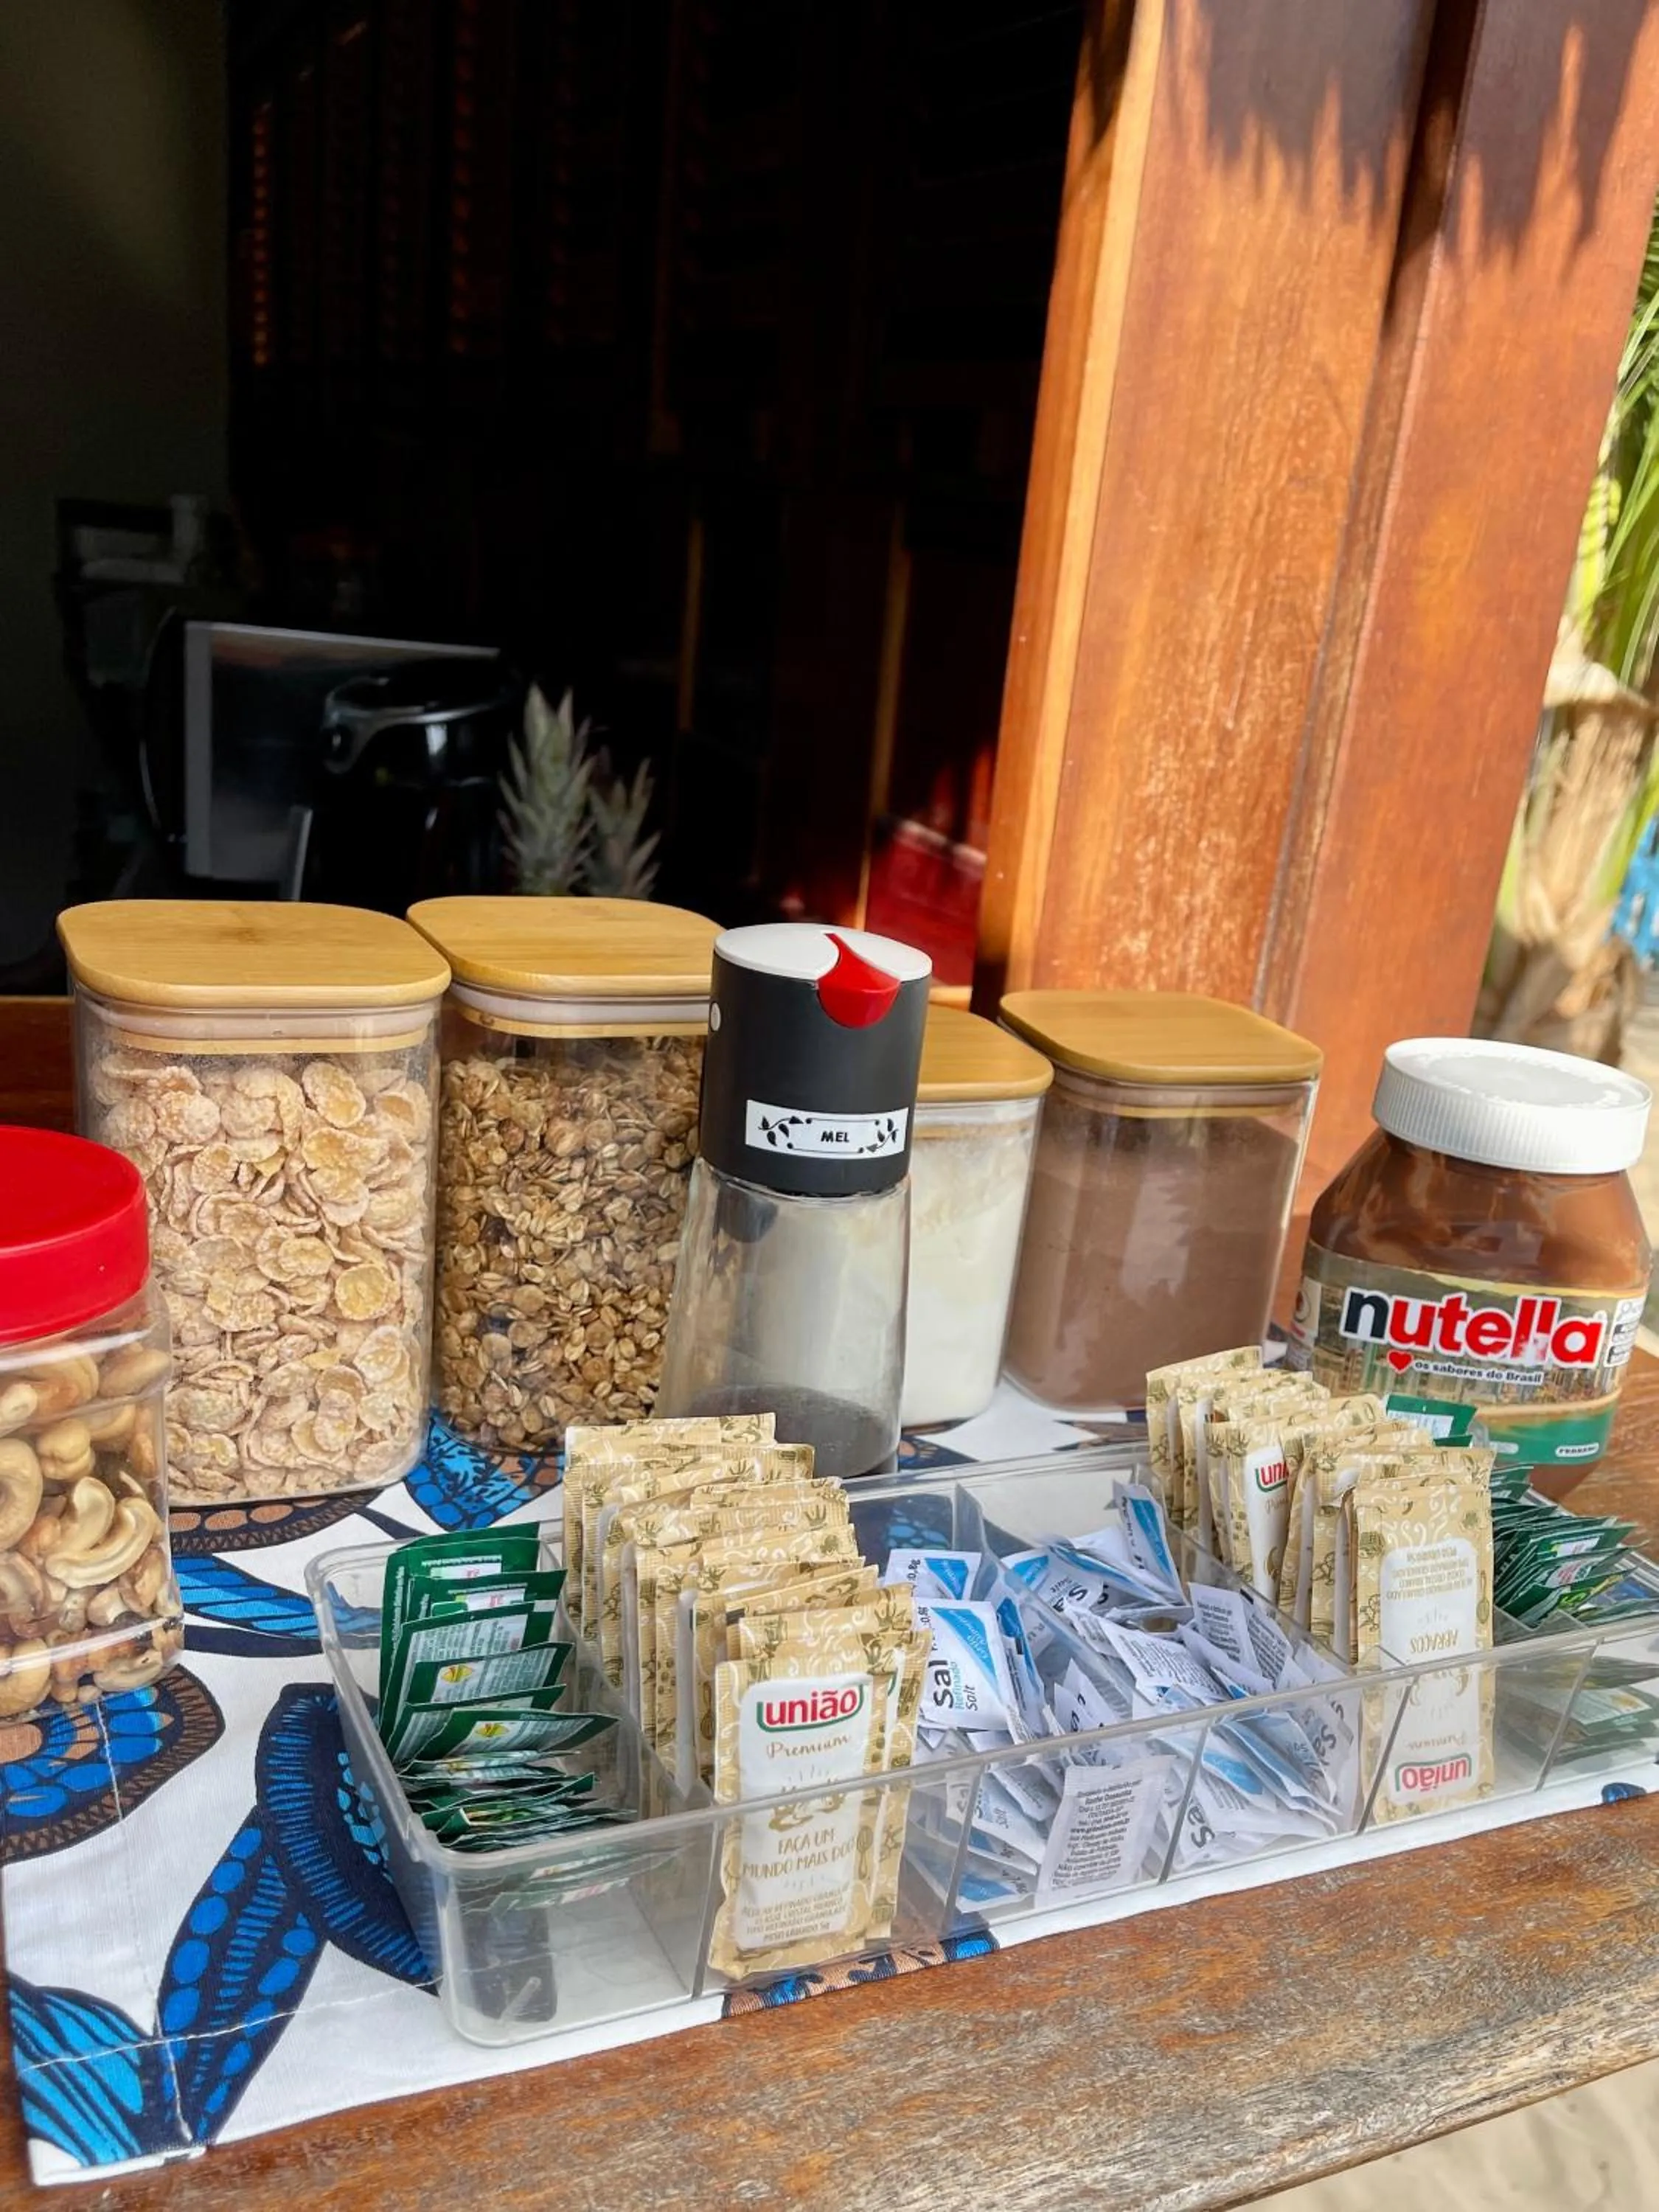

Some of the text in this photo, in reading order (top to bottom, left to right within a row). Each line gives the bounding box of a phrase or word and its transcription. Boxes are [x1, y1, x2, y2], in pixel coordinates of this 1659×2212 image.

[821, 1130, 850, 1143] MEL
[1342, 1290, 1606, 1365] nutella
[1415, 1361, 1542, 1382] os sabores do Brasil
[1260, 1461, 1290, 1486] uni
[928, 1659, 954, 1709] Sal
[965, 1683, 978, 1711] Salt
[765, 1688, 858, 1726] união
[766, 1734, 852, 1759] Premium
[1402, 1759, 1467, 1792] união
[814, 1828, 835, 1847] UM
[742, 1858, 793, 1879] MUNDO
[796, 1849, 828, 1871] MAIS
